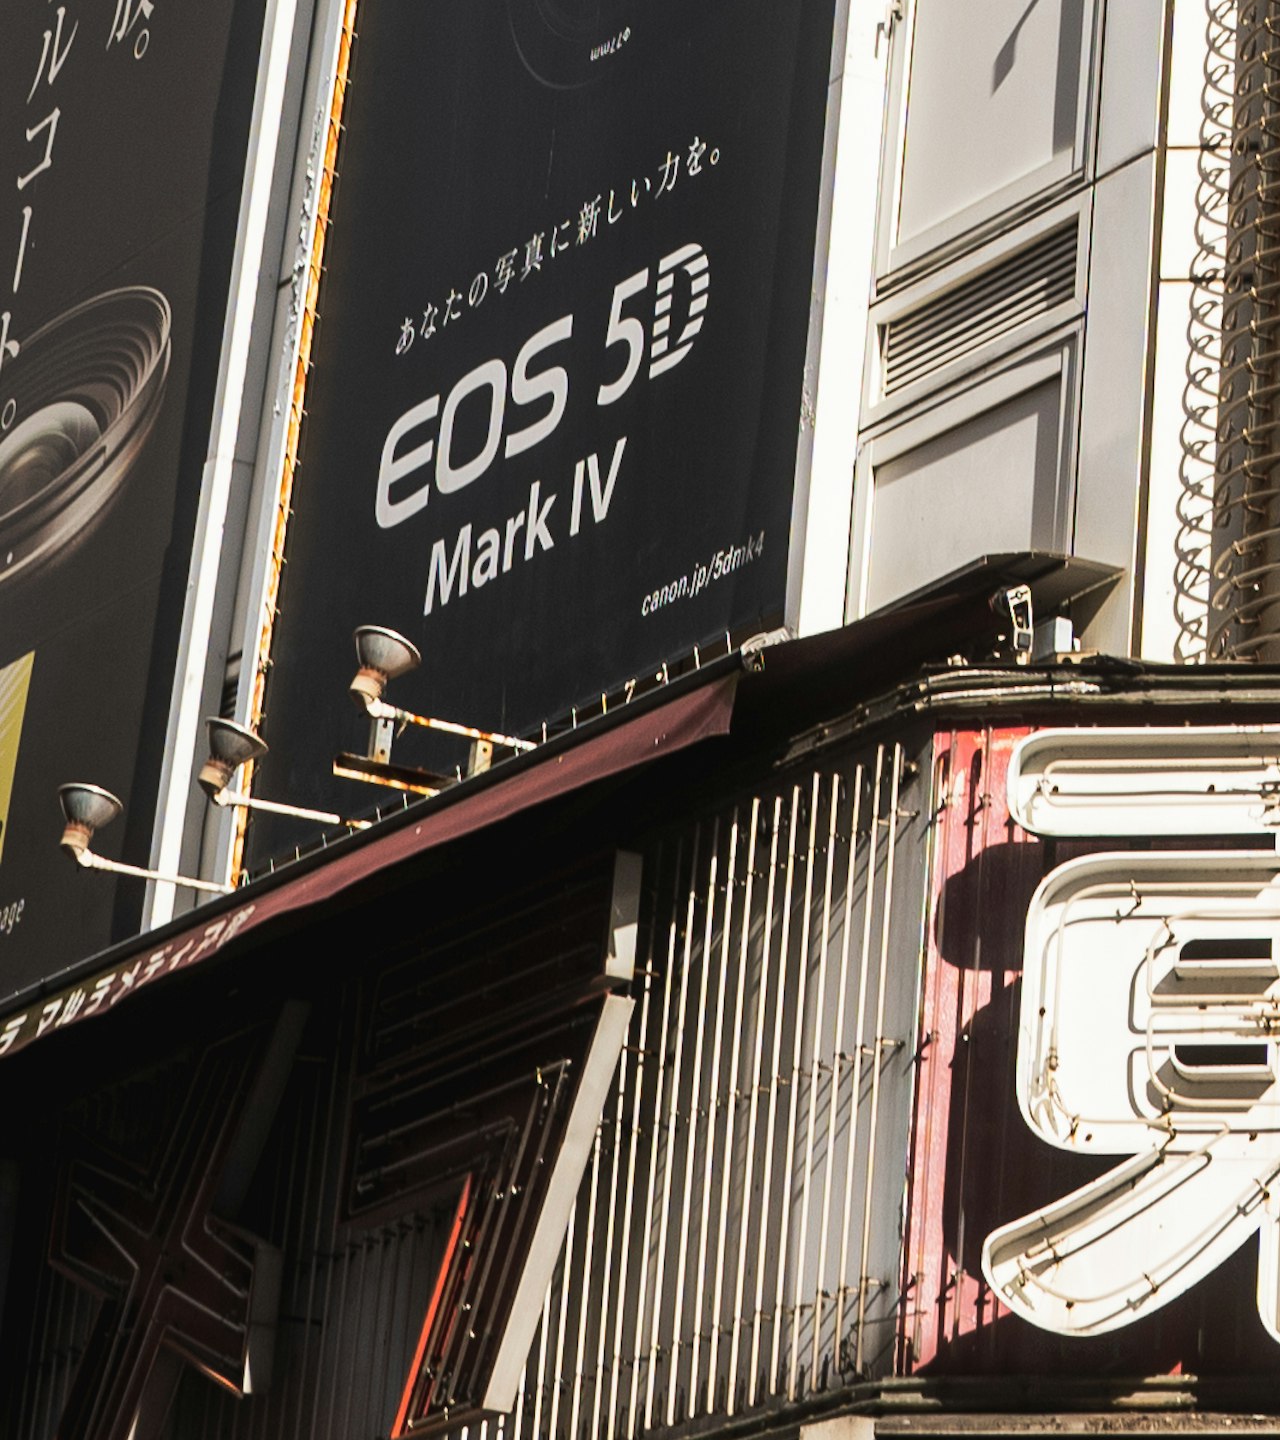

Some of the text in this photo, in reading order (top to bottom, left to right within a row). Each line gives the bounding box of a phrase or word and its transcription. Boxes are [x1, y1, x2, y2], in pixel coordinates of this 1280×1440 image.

[393, 134, 722, 357] あなたの写真に新しい力を。
[374, 241, 712, 531] EOS 5D
[422, 435, 629, 619] Mark IV
[640, 530, 766, 619] canon.jp/5dmk4
